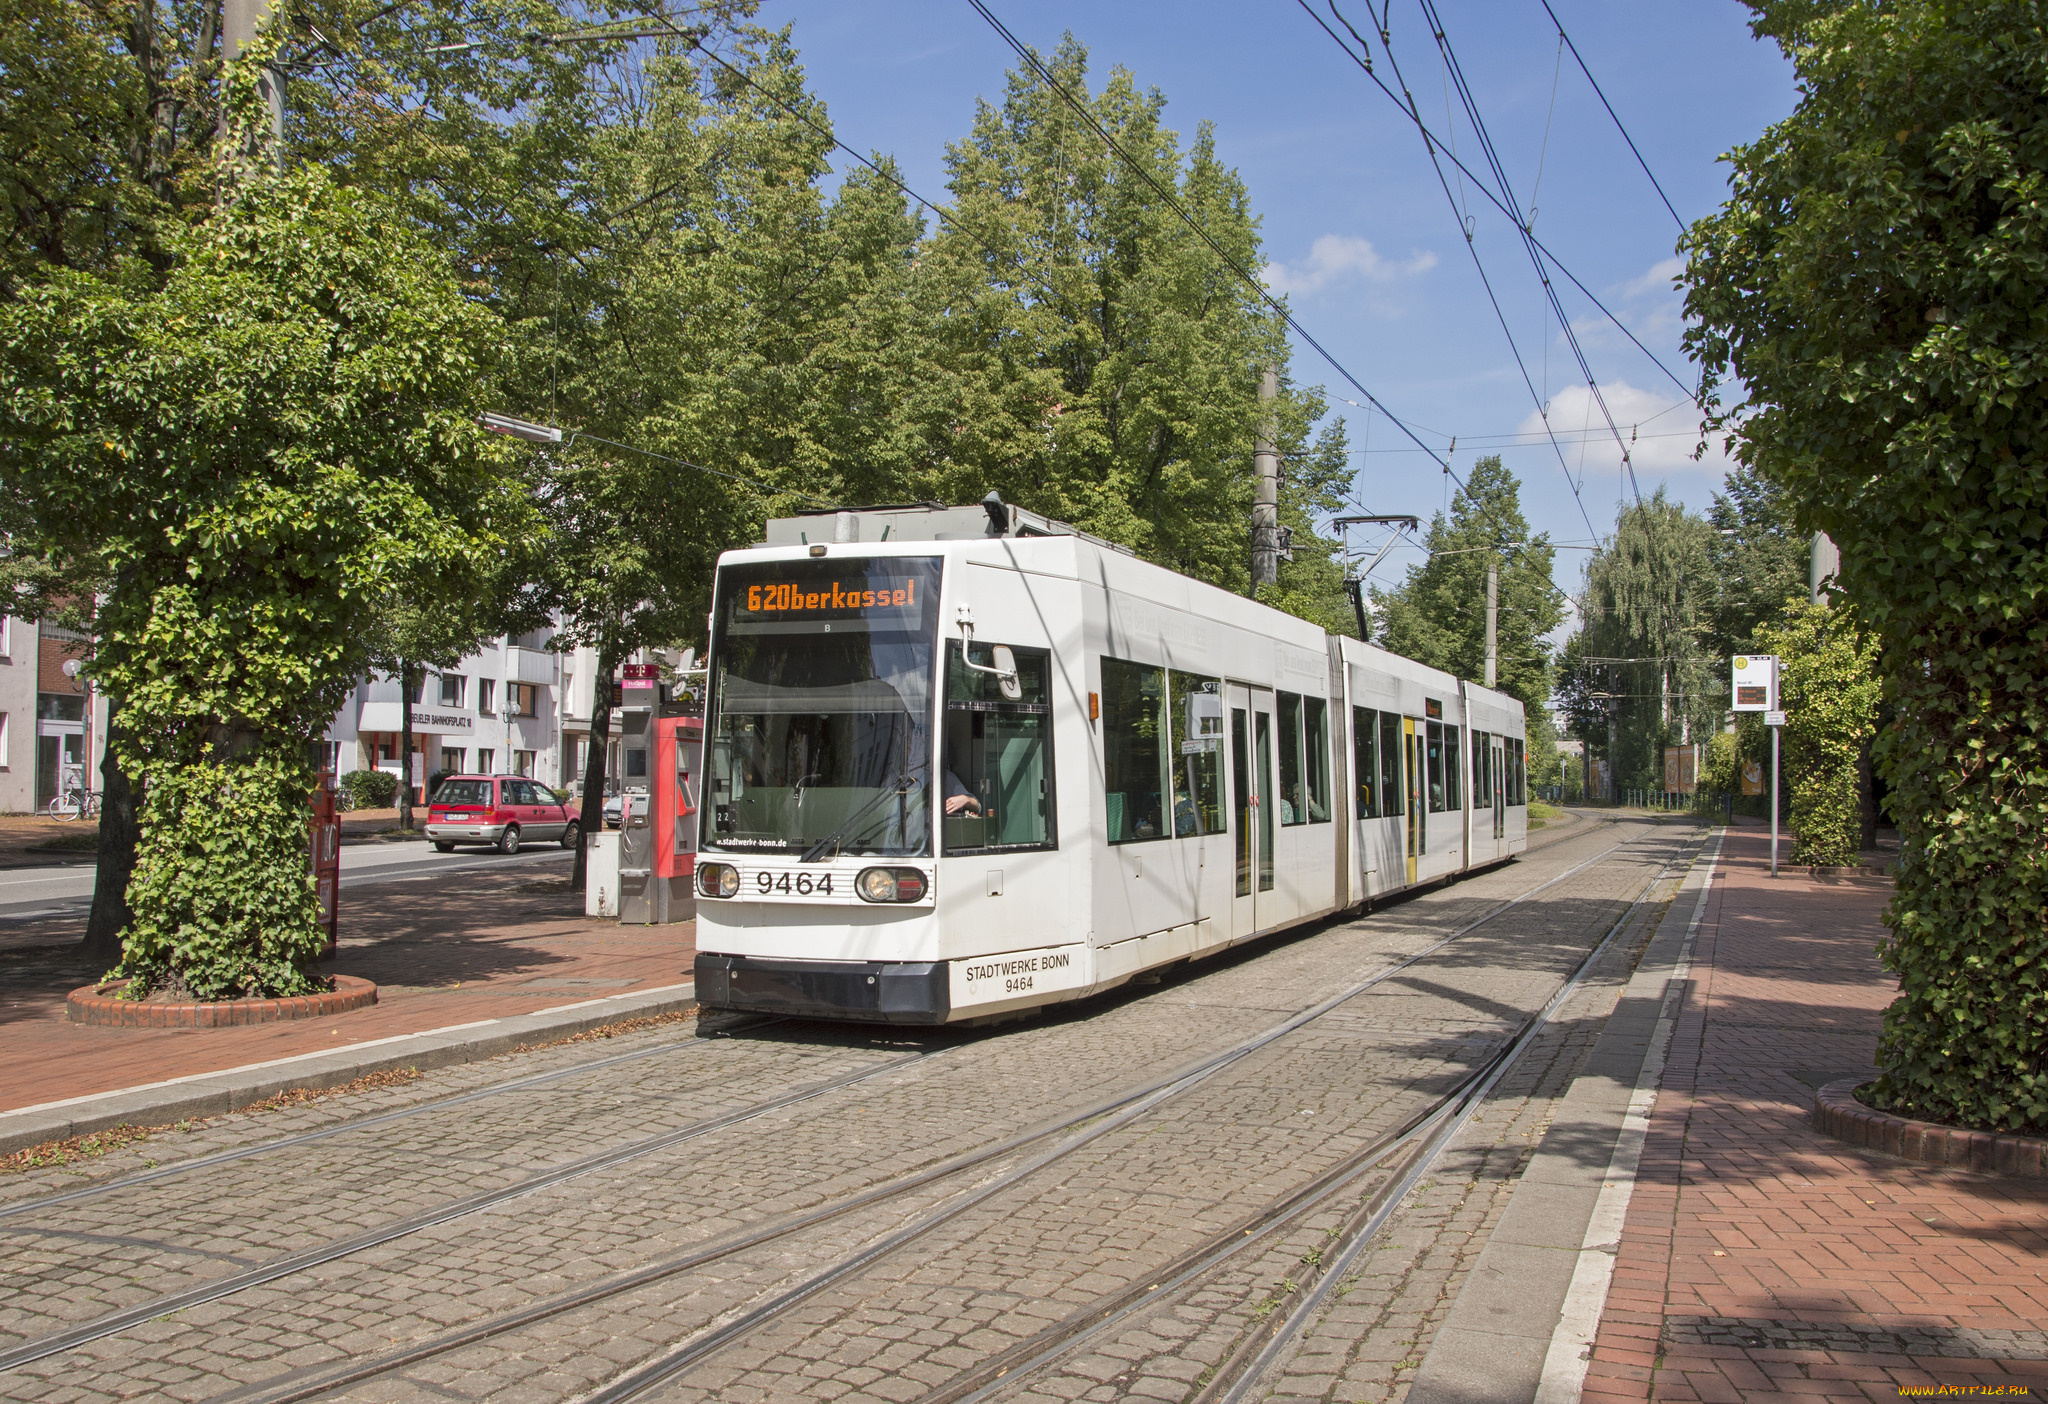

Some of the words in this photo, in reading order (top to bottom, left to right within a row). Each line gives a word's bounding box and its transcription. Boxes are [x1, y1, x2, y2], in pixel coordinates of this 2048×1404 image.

[824, 624, 831, 632] B
[757, 871, 834, 895] 9464
[966, 959, 1037, 981] STADTWERKE
[1042, 954, 1069, 969] BONN
[1006, 976, 1033, 992] 9464
